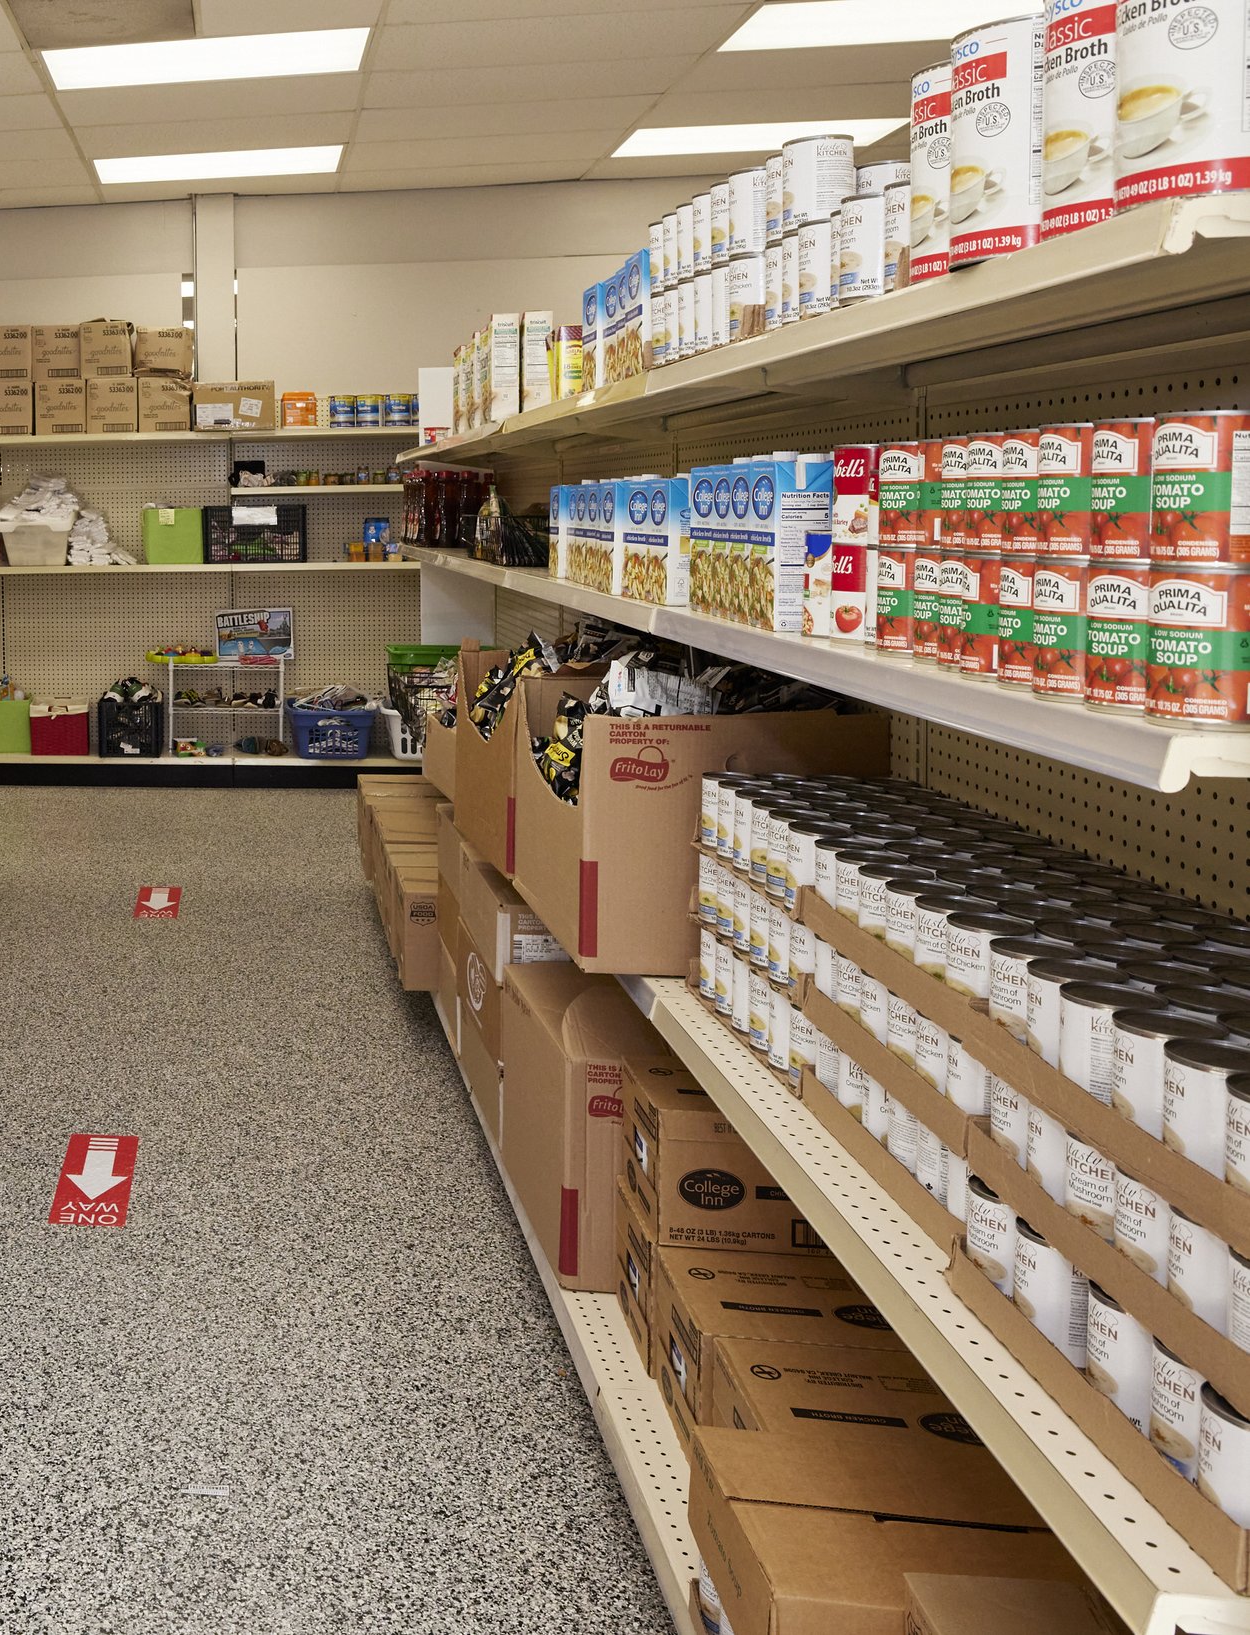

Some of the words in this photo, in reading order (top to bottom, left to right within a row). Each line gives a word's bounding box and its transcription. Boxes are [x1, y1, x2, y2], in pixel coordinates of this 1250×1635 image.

[1045, 17, 1092, 48] lassic
[1065, 39, 1108, 64] Broth
[966, 83, 1000, 105] Broth
[919, 120, 947, 141] Broth
[816, 148, 847, 157] KITCHEN
[1130, 181, 1138, 196] 49
[1139, 180, 1148, 194] OZ
[1149, 177, 1157, 194] (3
[1158, 177, 1169, 190] LB
[1178, 173, 1193, 189] OZ)
[1197, 171, 1217, 185] 1.39
[1218, 170, 1232, 185] kg
[1158, 432, 1193, 446] PRIMA
[753, 486, 773, 501] College
[1153, 484, 1204, 496] TOMATO
[631, 501, 647, 511] College
[758, 503, 768, 515] Inn
[1156, 497, 1191, 509] SOUP
[1095, 584, 1131, 596] PRIMA
[1159, 589, 1201, 601] PRIMA
[217, 612, 270, 627] BATTLESHIP
[1088, 630, 1140, 644] TOMATO
[1170, 631, 1203, 639] SODIUM
[1092, 643, 1128, 655] SOUP
[1151, 638, 1212, 654] TOMATO
[1157, 652, 1198, 665] SOUP
[1183, 703, 1197, 713] (305
[1199, 705, 1228, 716] GRAMS)
[1071, 1172, 1097, 1190] Cream
[684, 1180, 740, 1198] College
[1069, 1180, 1113, 1204] Mushroom
[701, 1194, 723, 1206] Inn
[61, 1202, 118, 1212] WAY
[59, 1212, 117, 1224] ONE
